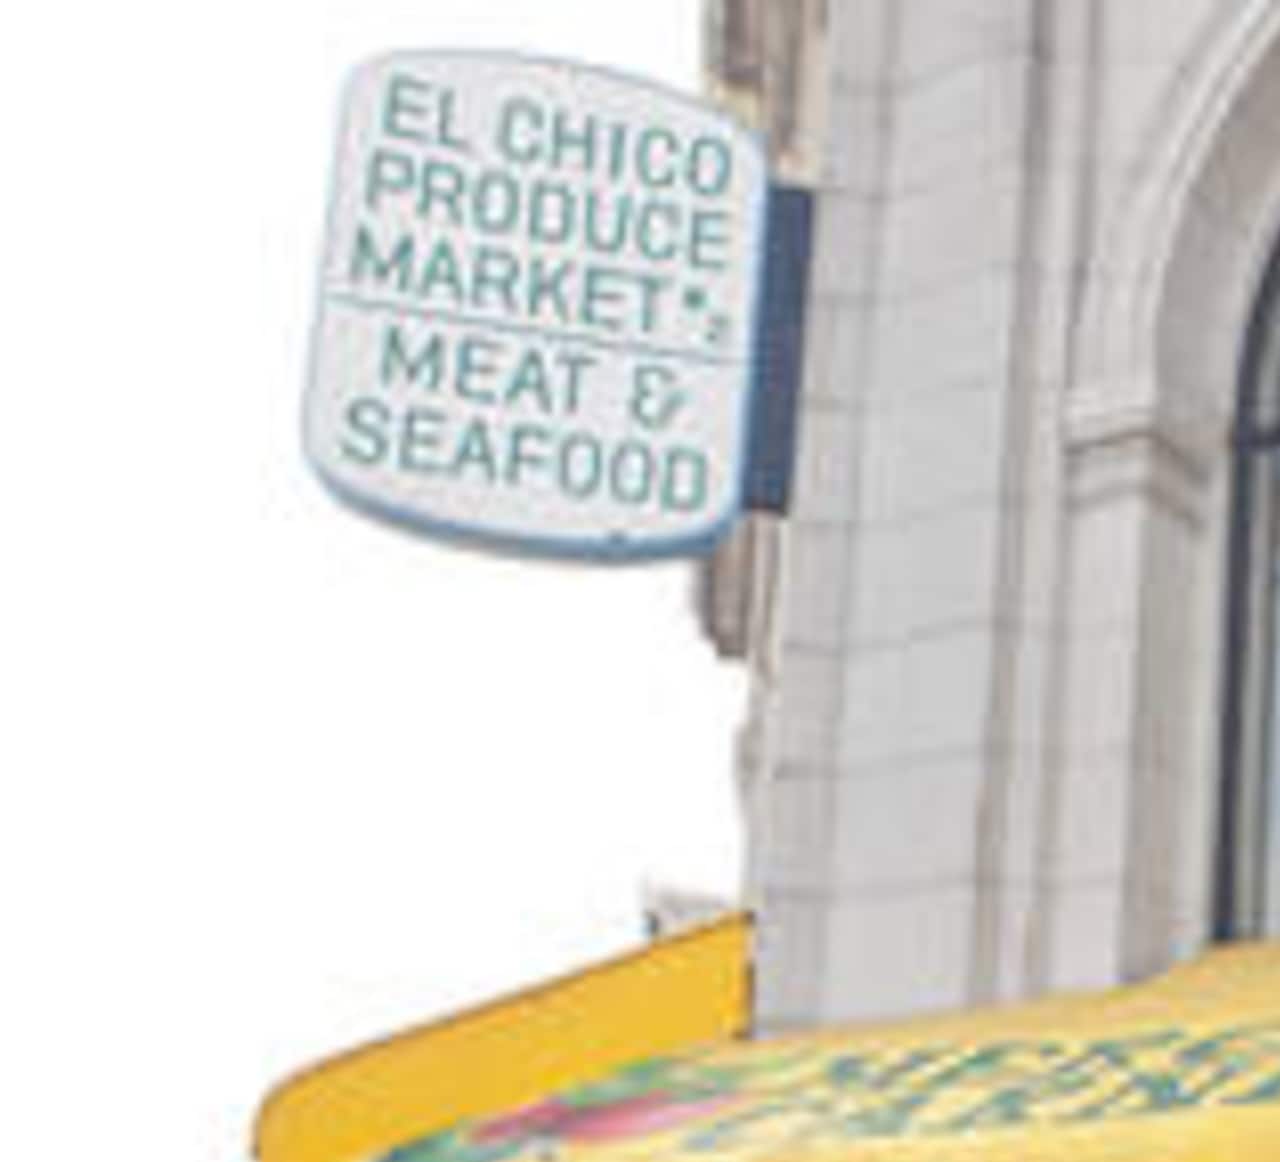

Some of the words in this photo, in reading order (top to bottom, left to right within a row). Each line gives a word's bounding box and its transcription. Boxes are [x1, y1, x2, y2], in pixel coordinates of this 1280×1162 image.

[382, 71, 468, 150] EL
[496, 94, 734, 198] CHICO
[362, 148, 731, 272] PRODUCE
[348, 221, 672, 334] MARKET
[378, 326, 597, 415] MEAT
[631, 362, 692, 431] &
[338, 396, 711, 515] SEAFOOD
